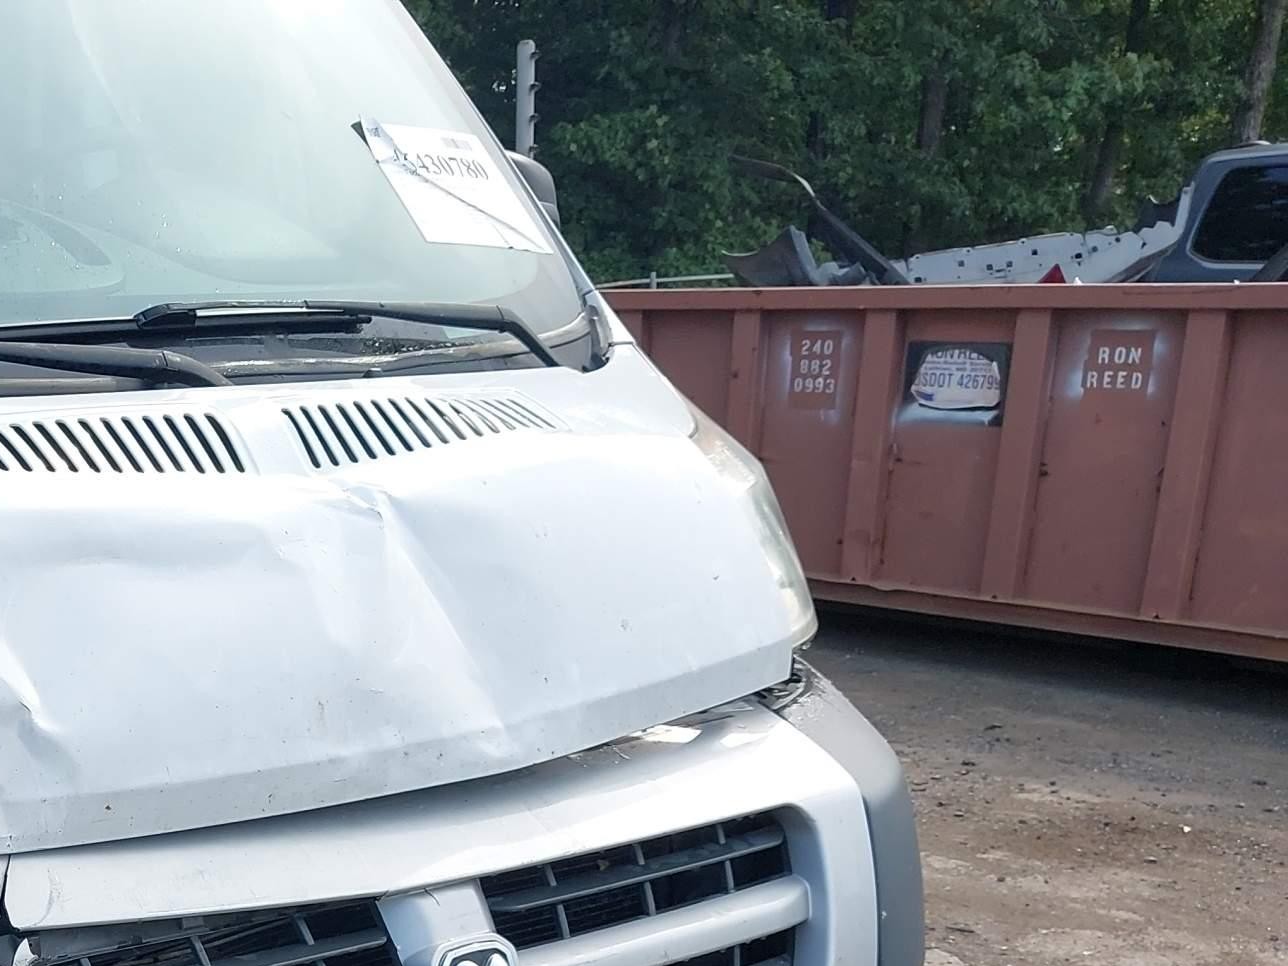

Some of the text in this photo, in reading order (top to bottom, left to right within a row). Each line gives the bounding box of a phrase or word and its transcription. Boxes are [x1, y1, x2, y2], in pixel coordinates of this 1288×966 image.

[801, 339, 834, 356] 240
[1098, 346, 1143, 365] RON
[799, 359, 832, 376] 882
[793, 377, 835, 394] 0993
[1086, 370, 1143, 389] REED
